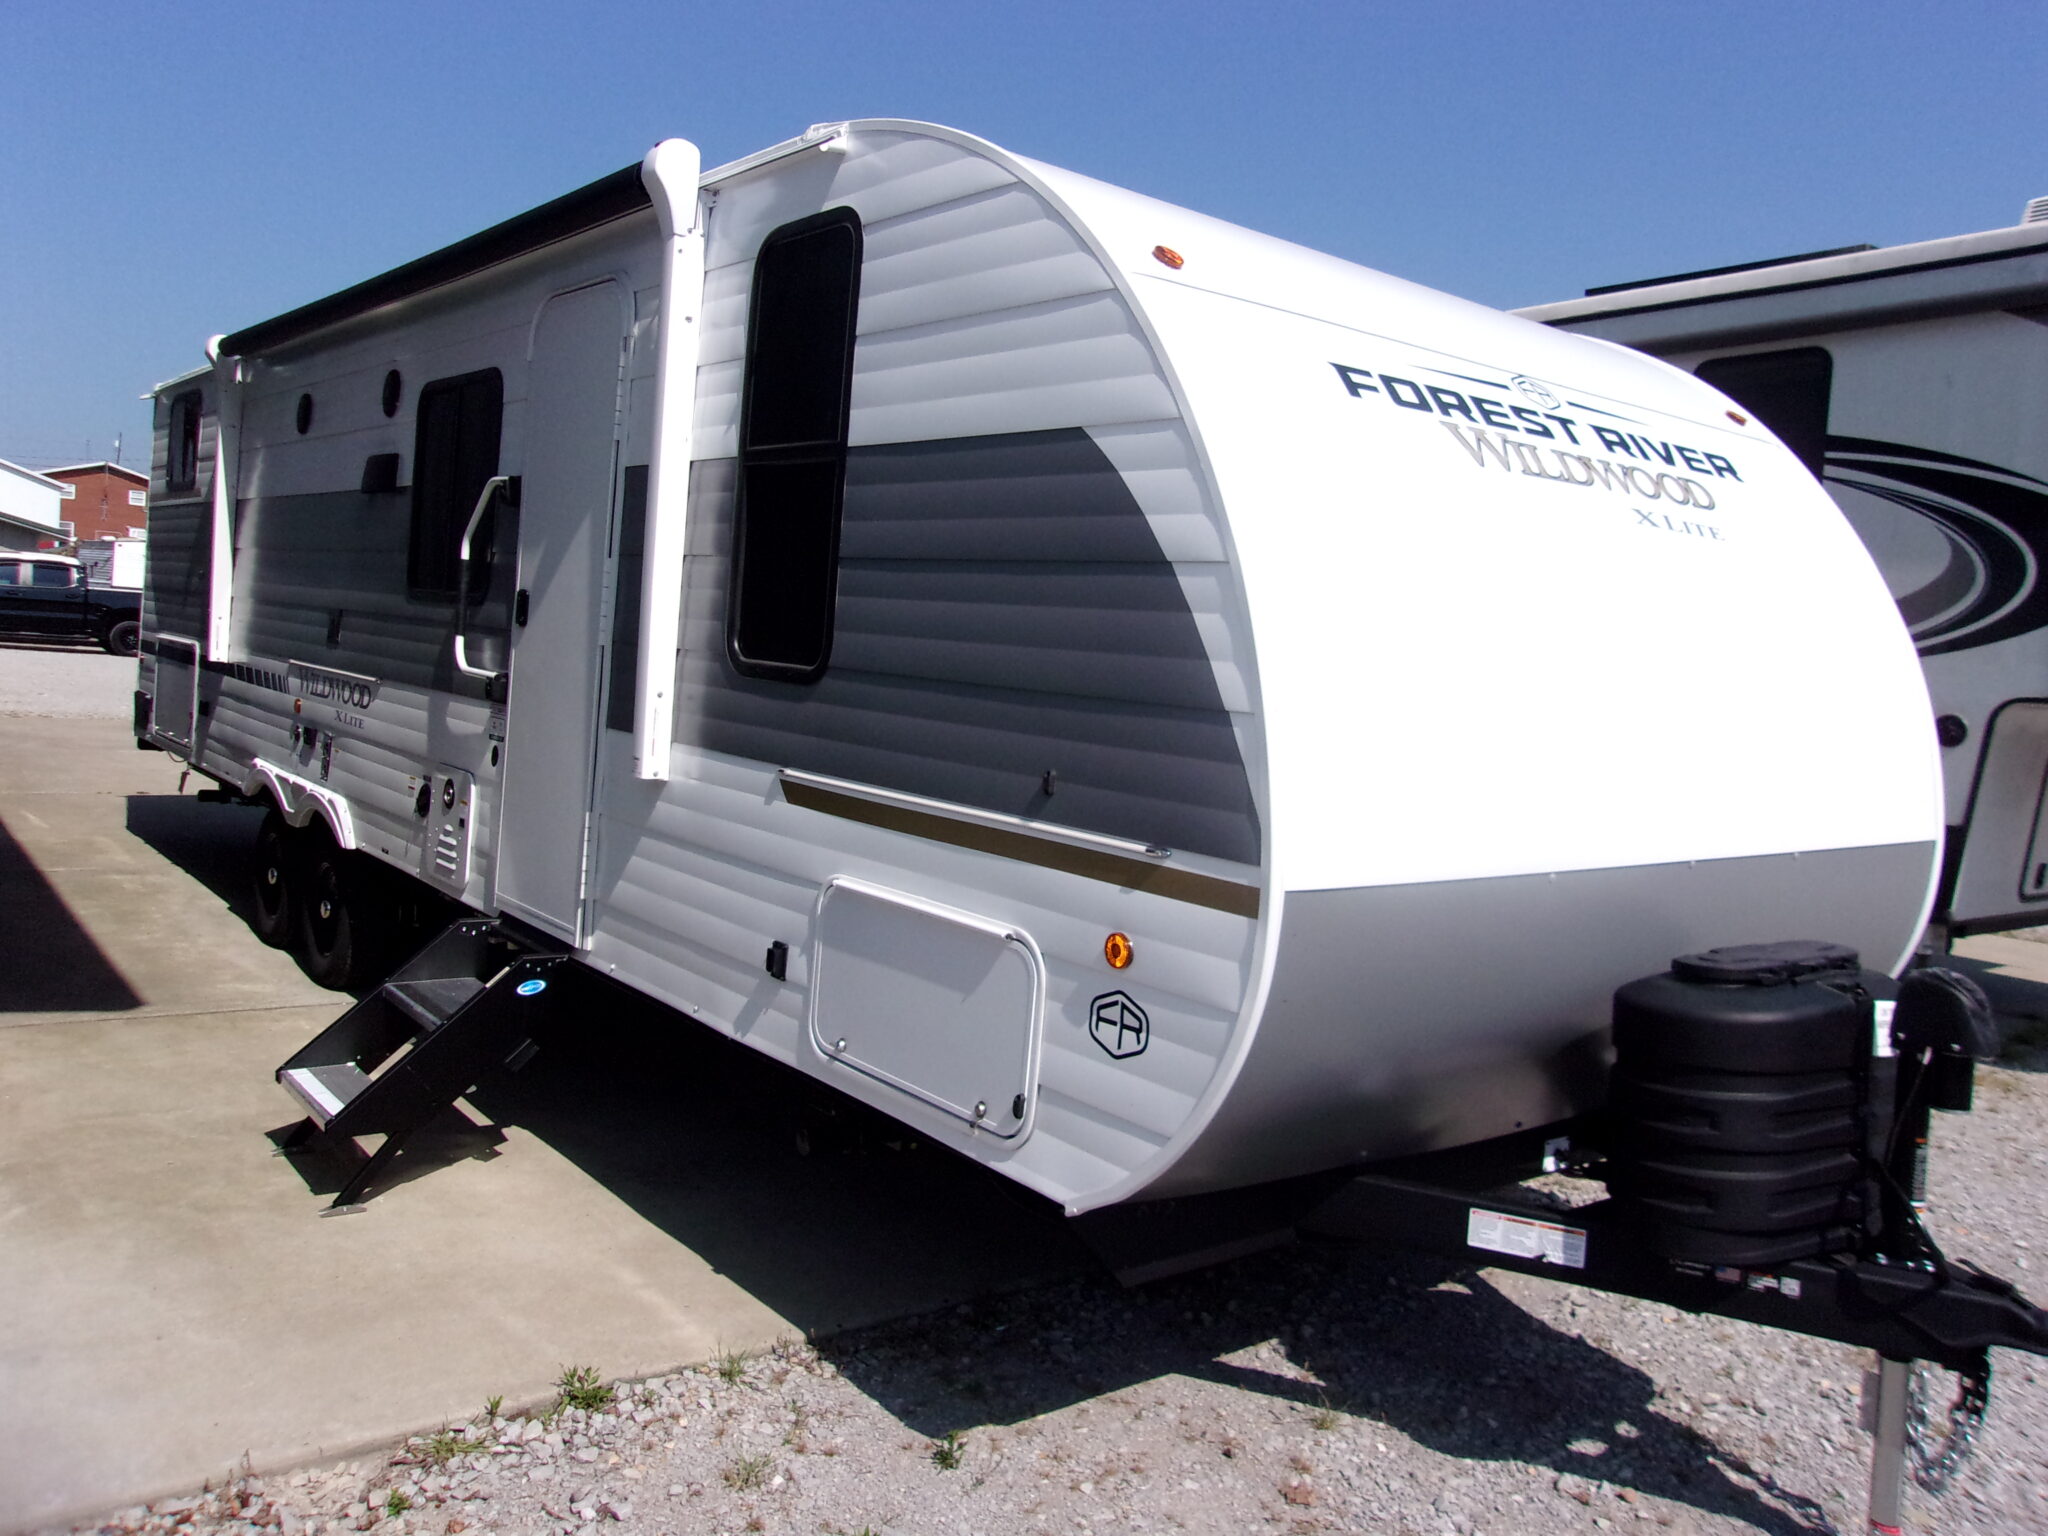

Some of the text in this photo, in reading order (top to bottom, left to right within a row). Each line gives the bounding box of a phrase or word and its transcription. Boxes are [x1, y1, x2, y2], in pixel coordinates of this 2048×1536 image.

[1328, 361, 1744, 483] FOREST RIVER
[1439, 420, 1716, 511] WILDWOOD
[299, 668, 372, 709] WILDWOOD
